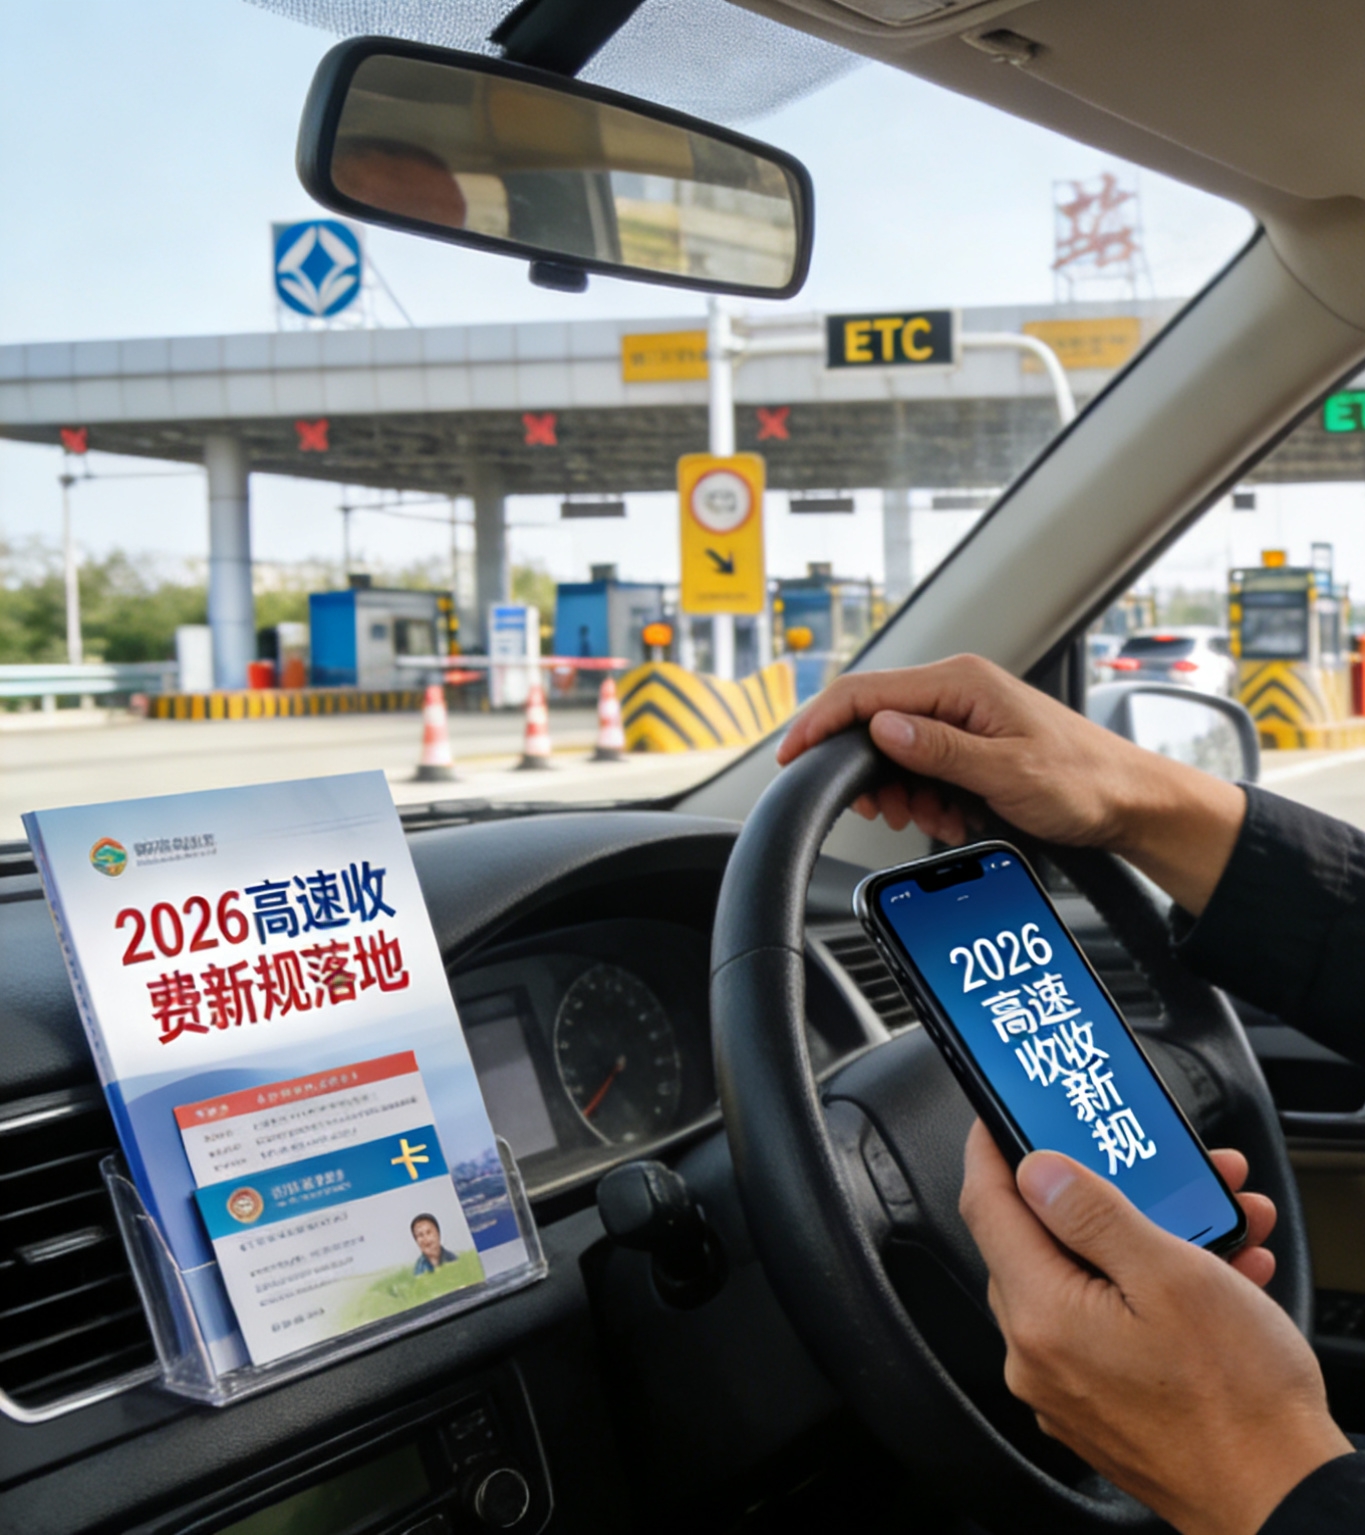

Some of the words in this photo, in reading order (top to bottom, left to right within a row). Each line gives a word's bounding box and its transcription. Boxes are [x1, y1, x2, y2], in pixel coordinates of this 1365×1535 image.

[844, 318, 933, 363] ETC
[115, 861, 396, 966] 2026高速收
[146, 929, 410, 1045] 费新规落地
[949, 922, 1053, 993] 2026
[981, 972, 1082, 1043] 高速
